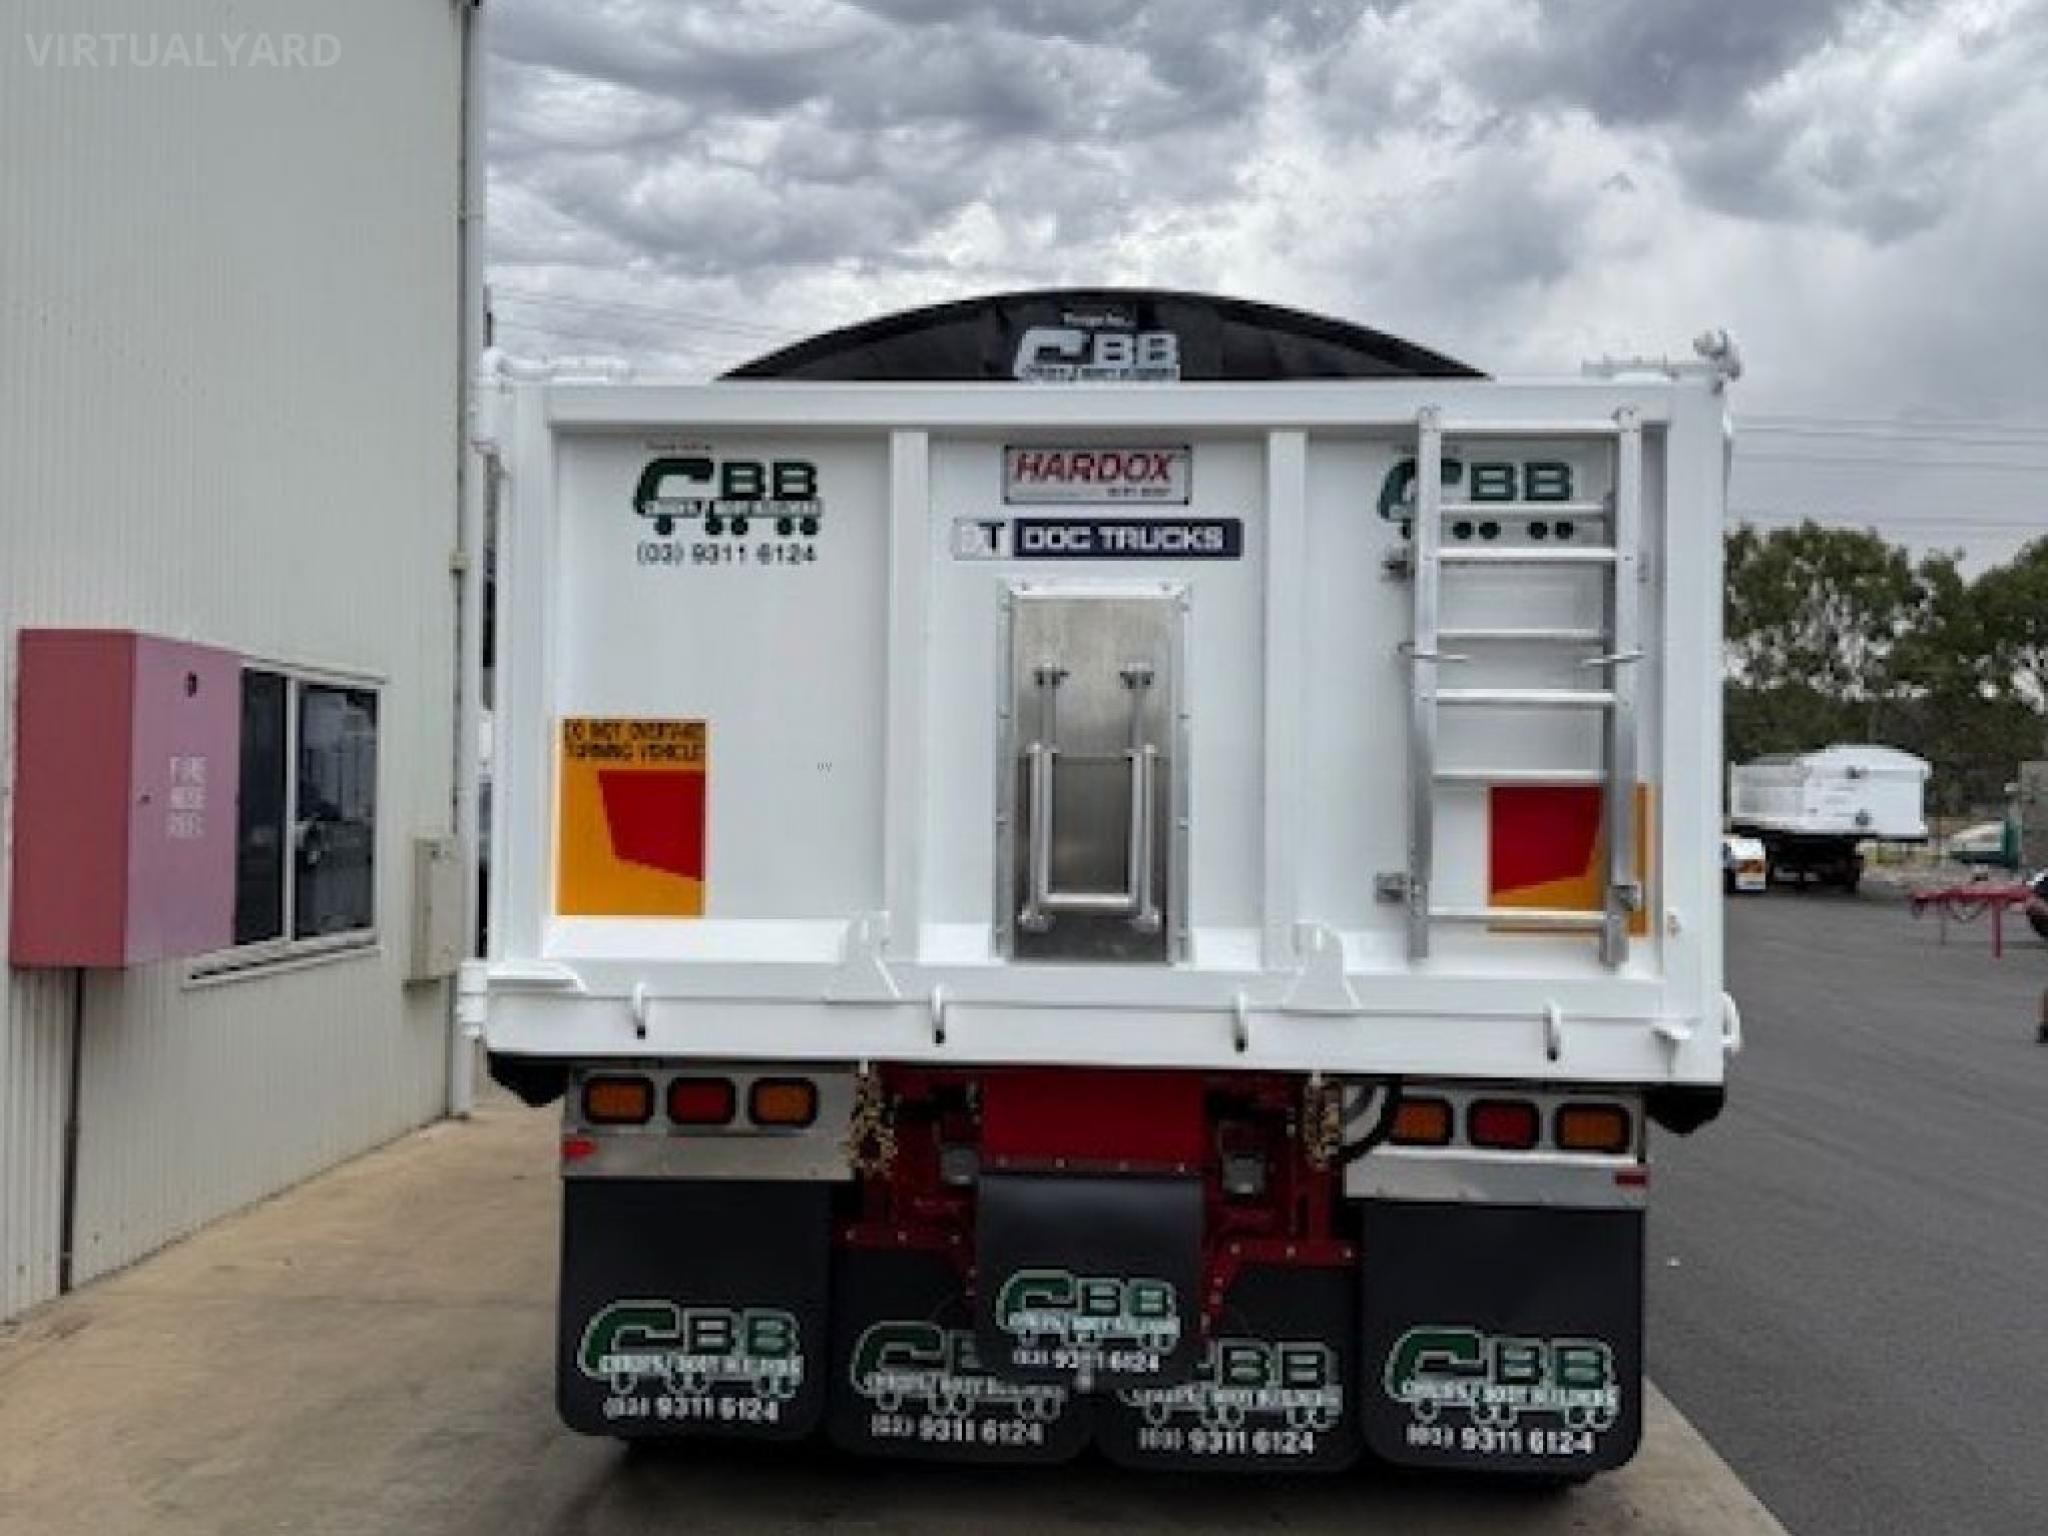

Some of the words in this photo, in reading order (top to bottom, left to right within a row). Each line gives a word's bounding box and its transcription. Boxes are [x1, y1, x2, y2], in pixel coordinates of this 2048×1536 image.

[1013, 326, 1178, 378] CBB
[1015, 453, 1178, 484] HARDOX
[634, 457, 818, 514] CBB
[1098, 526, 1223, 551] TRUCKS
[692, 543, 748, 565] 9311
[757, 543, 817, 565] 6124
[995, 1269, 1178, 1331] CBB
[577, 1299, 799, 1376] CBB
[1384, 1328, 1614, 1402] CBB
[656, 1398, 715, 1421] 9311
[720, 1398, 779, 1421] 6124
[919, 1415, 977, 1441] 9311
[981, 1420, 1044, 1445] 6124
[1188, 1428, 1246, 1454] 9311
[1251, 1428, 1315, 1454] 6124
[1460, 1427, 1522, 1453] 9311
[1528, 1428, 1594, 1454] 6124
